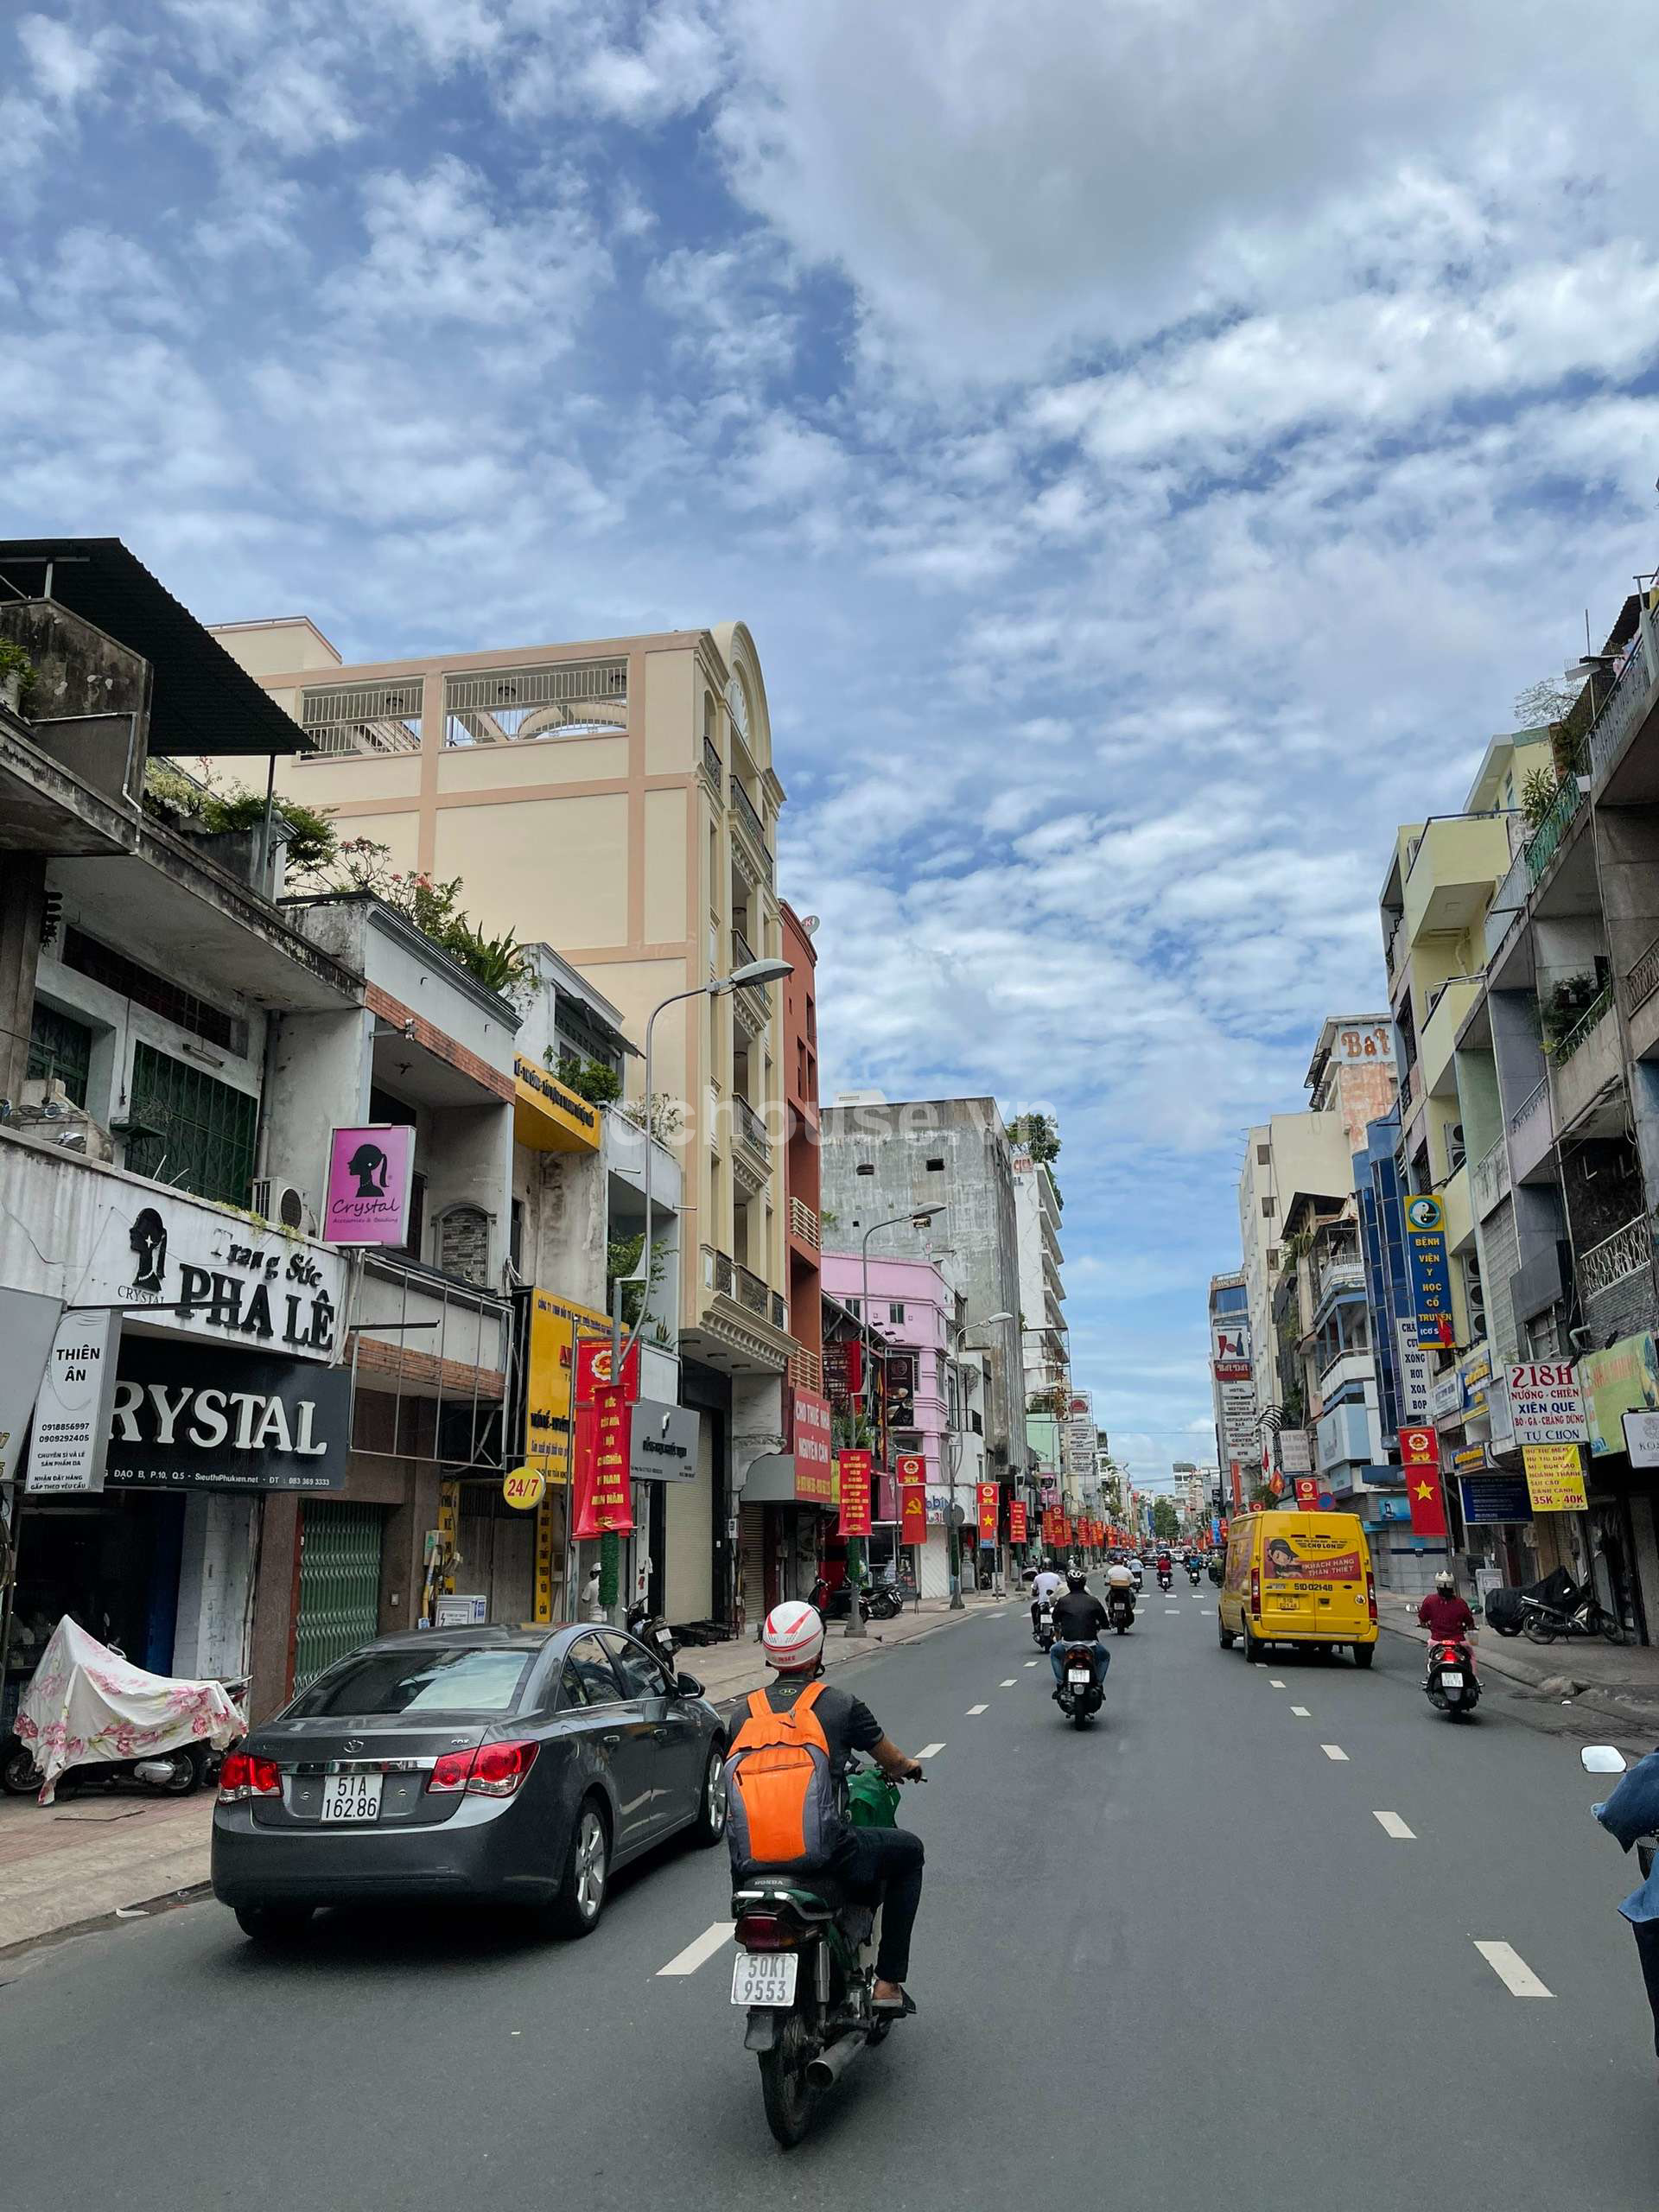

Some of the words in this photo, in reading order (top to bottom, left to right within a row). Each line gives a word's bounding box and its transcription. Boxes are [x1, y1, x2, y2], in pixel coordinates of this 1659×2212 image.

[332, 1198, 401, 1217] Crystal
[1415, 1236, 1440, 1249] BỆNH
[1419, 1253, 1440, 1265] VIỆN
[286, 1253, 323, 1287] Sức
[1427, 1268, 1433, 1276] Y
[1422, 1282, 1442, 1294] HỌC
[175, 1263, 274, 1337] PHA
[283, 1288, 335, 1351] LÊ
[1402, 1321, 1417, 1332] CHÂ
[56, 1344, 100, 1361] THIÊN
[65, 1365, 86, 1382] ÂN
[1511, 1364, 1574, 1389] 218H
[1518, 1402, 1548, 1414] XIÊN
[1551, 1402, 1576, 1414] QUE
[109, 1380, 327, 1455] RYSTAL
[41, 1422, 90, 1431] 0918856997
[1545, 1429, 1580, 1441] CHỌN
[114, 1469, 133, 1480] ĐẠO
[506, 1478, 539, 1497] 24/7
[1534, 1496, 1554, 1505] 35K
[1563, 1495, 1584, 1503] 40K
[337, 1777, 366, 1796] 51A
[326, 1797, 377, 1820] 162.86
[744, 1980, 786, 2000] 9553
